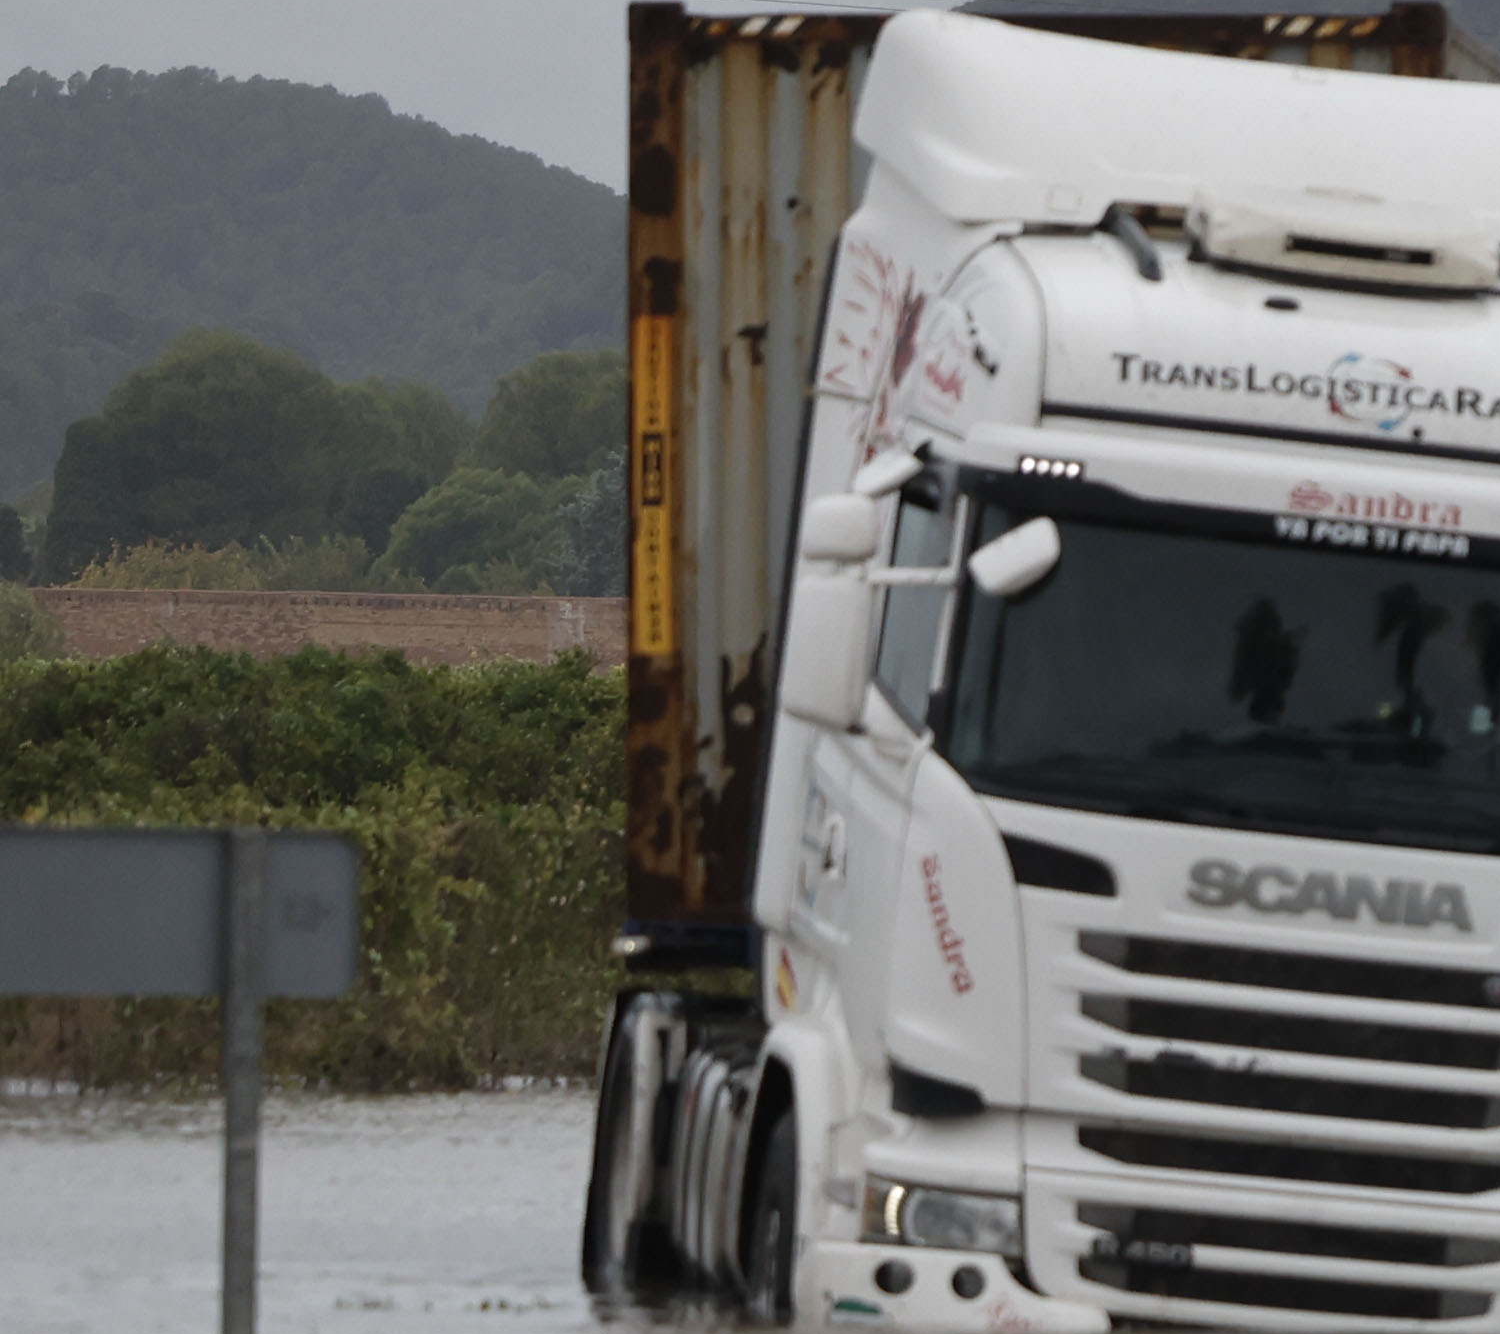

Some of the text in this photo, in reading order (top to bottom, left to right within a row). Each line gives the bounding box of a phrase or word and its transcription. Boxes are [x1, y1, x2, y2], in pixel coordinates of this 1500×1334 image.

[1312, 519, 1369, 547] POR
[1373, 525, 1399, 550] TI
[1187, 857, 1474, 932] SCANIA
